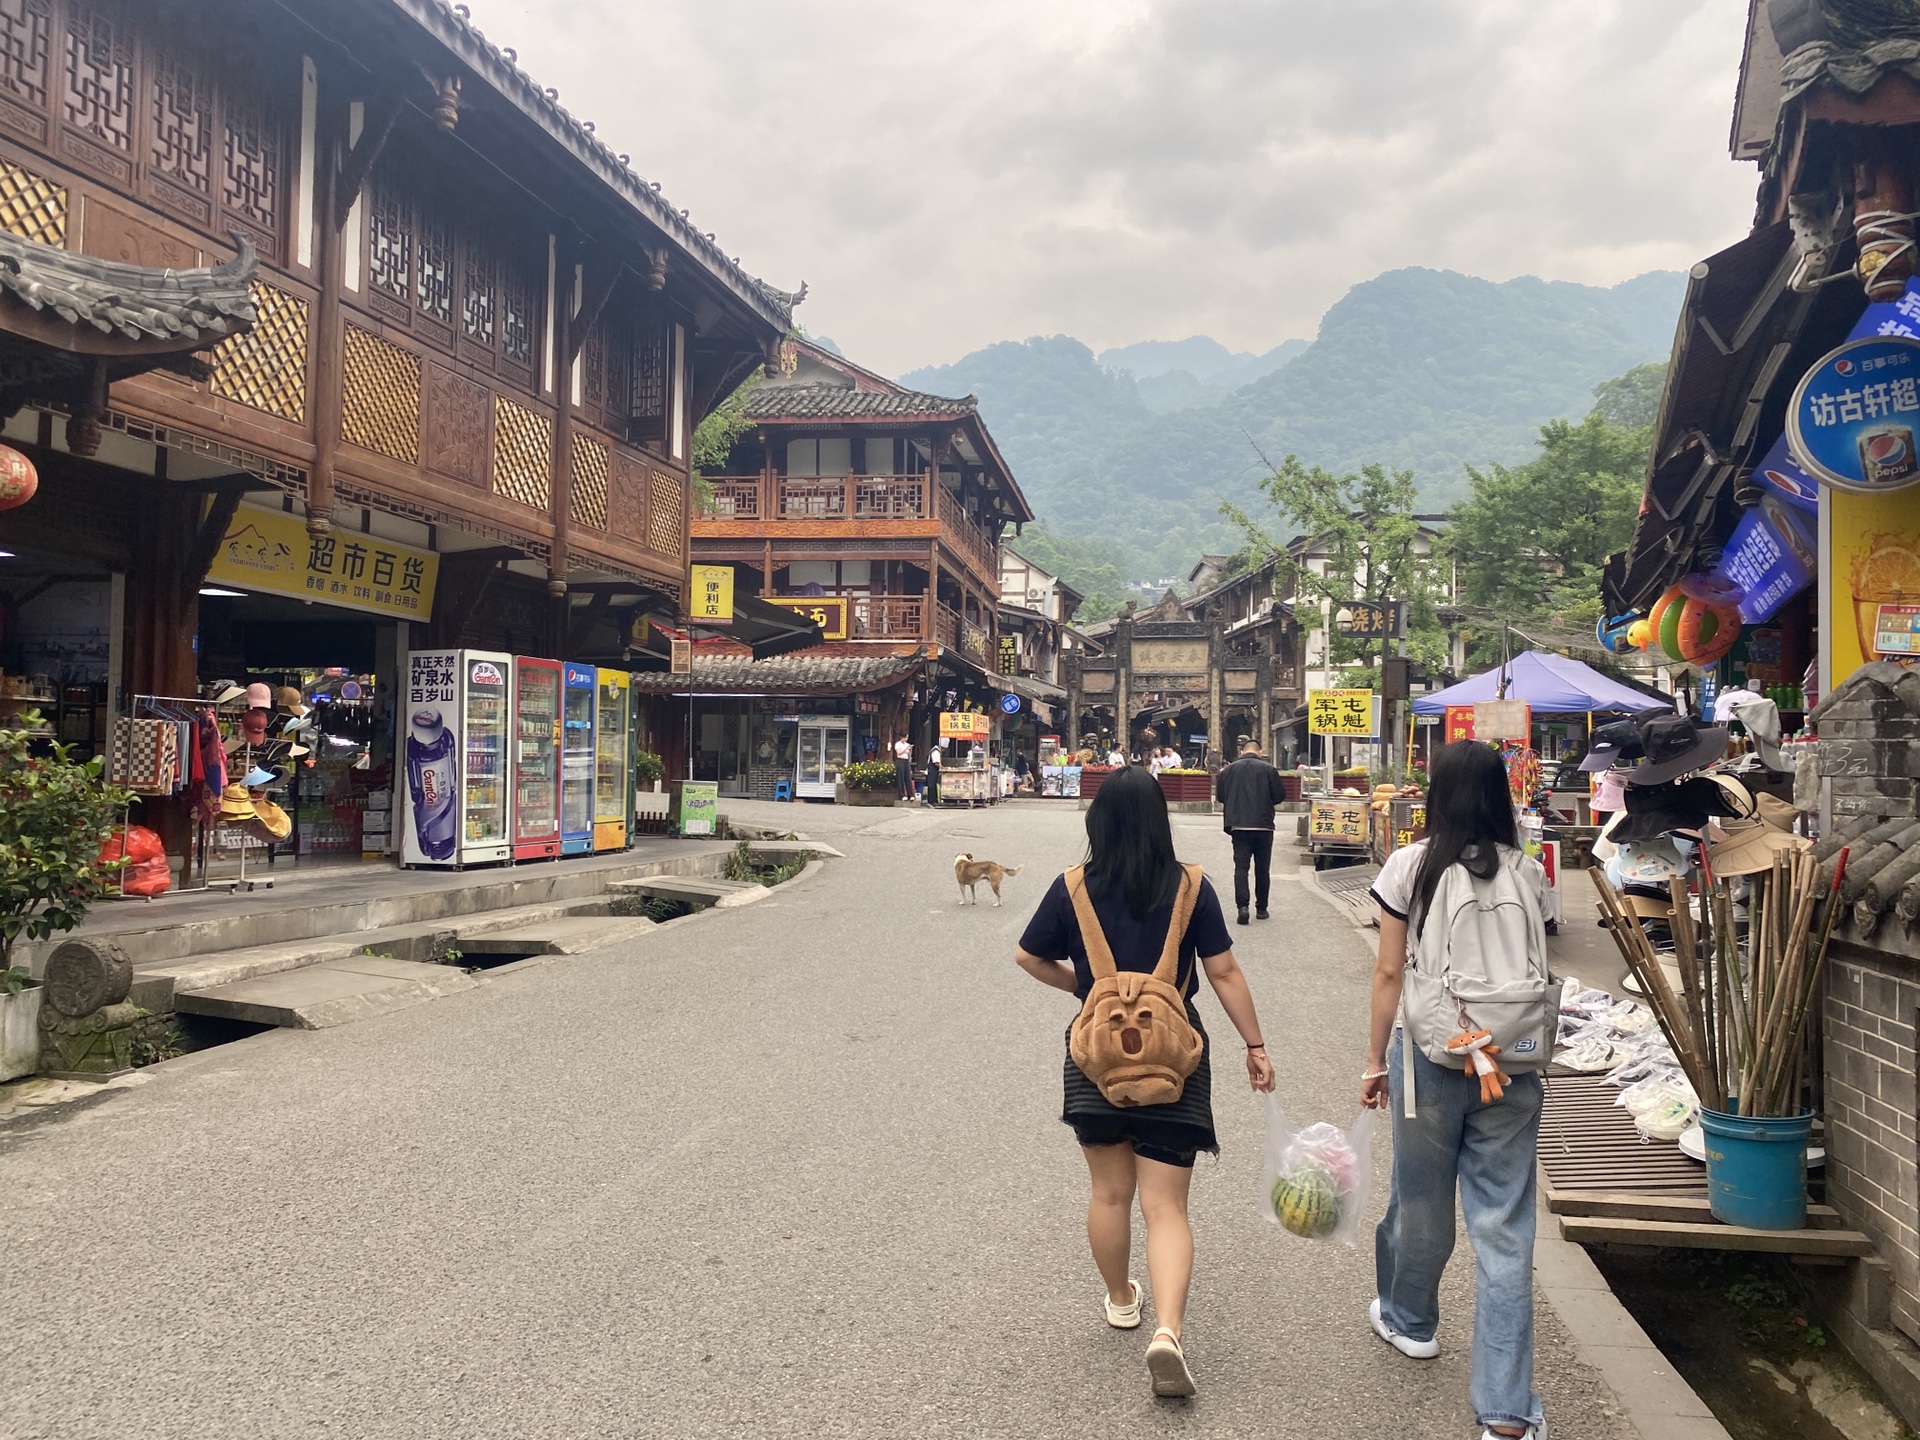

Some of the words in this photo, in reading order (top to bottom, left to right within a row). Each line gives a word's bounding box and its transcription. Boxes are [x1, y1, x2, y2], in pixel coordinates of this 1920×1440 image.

[1861, 353, 1911, 372] 百事可乐
[1810, 377, 1920, 427] 访古轩超
[1875, 464, 1909, 479] pepsi
[306, 537, 424, 594] 超市百货
[306, 576, 325, 591] 香烟
[330, 581, 348, 595] 酒水
[353, 585, 370, 600] 饮料
[375, 590, 392, 604] 副食
[394, 594, 418, 609] 日用品
[705, 582, 719, 615] 便利店
[1349, 606, 1395, 632] 烧烤
[1001, 638, 1013, 648] 茶
[412, 656, 455, 669] 真正天然
[412, 669, 454, 686] 矿泉水
[411, 688, 453, 702] 百岁山
[1314, 698, 1366, 713] 军屯
[1314, 713, 1366, 728] 锅魁
[1317, 808, 1360, 823] 军屯
[1316, 821, 1360, 836] 锅魁
[1398, 830, 1414, 845] 红
